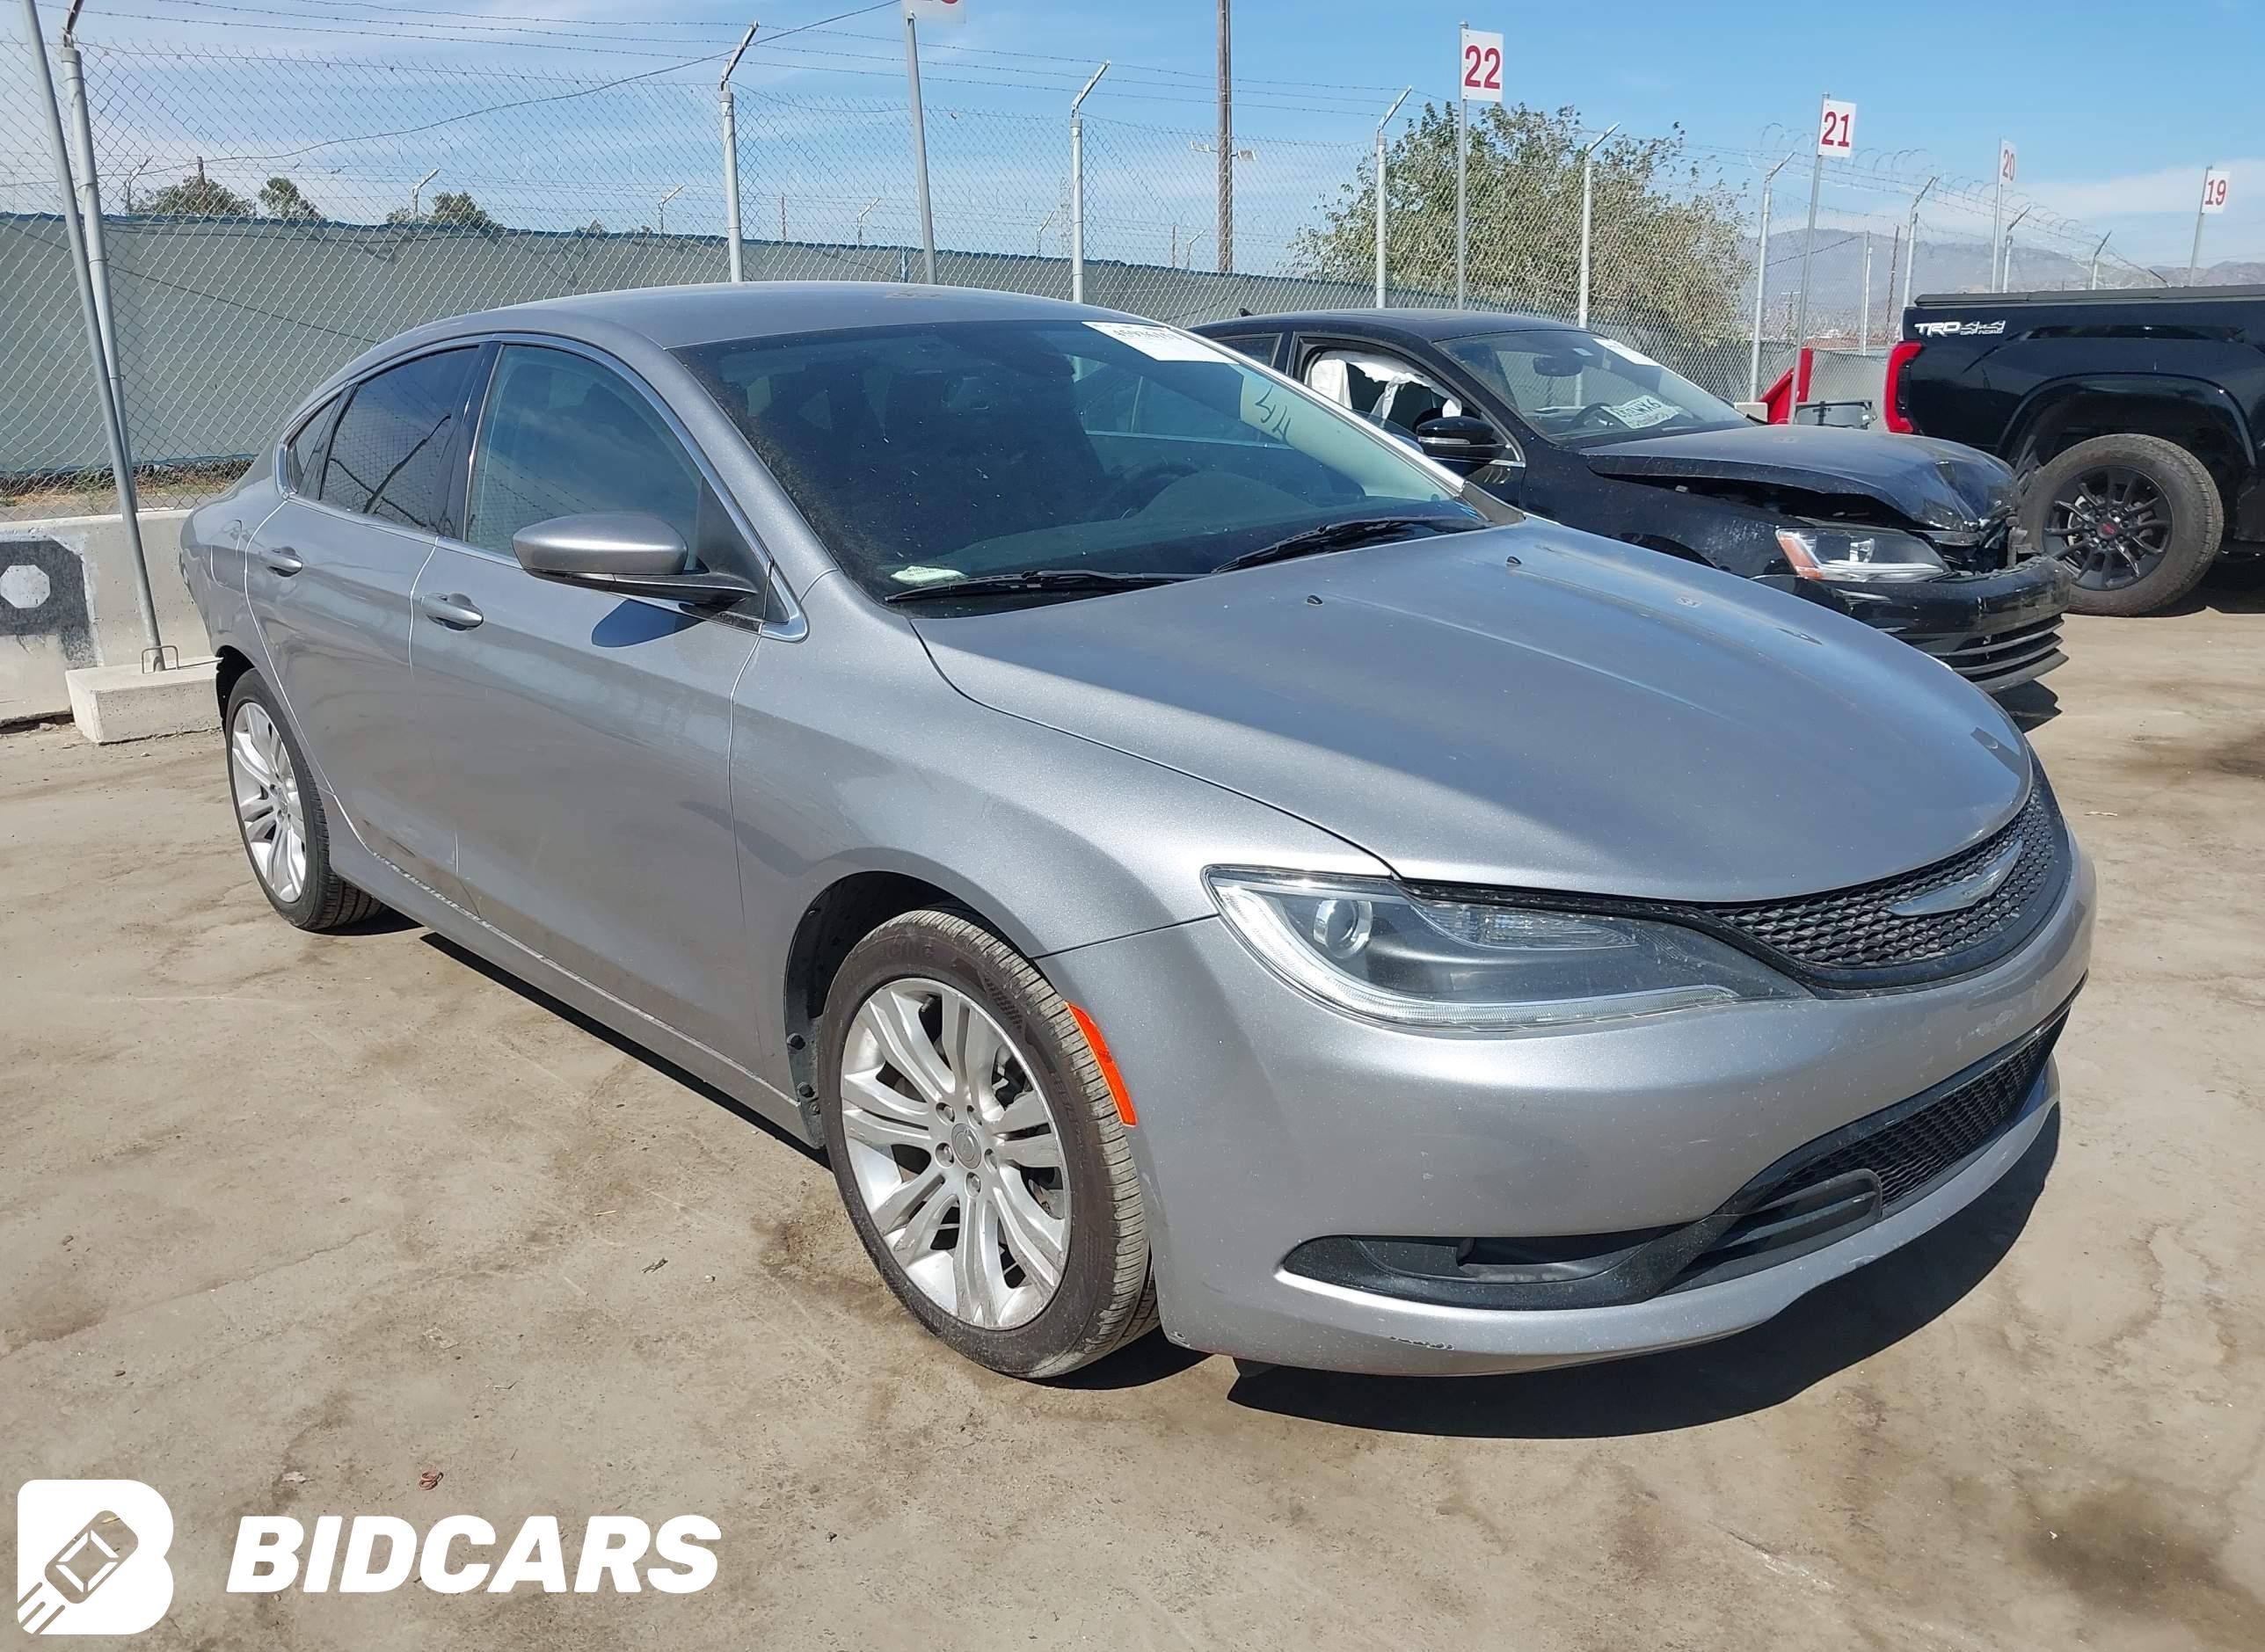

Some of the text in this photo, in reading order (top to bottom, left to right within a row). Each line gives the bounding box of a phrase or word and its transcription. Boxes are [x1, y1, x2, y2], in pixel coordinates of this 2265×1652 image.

[1464, 45, 1501, 90] 22
[1821, 111, 1850, 148] 21
[2002, 149, 2015, 181] 20
[2204, 178, 2226, 206] 19
